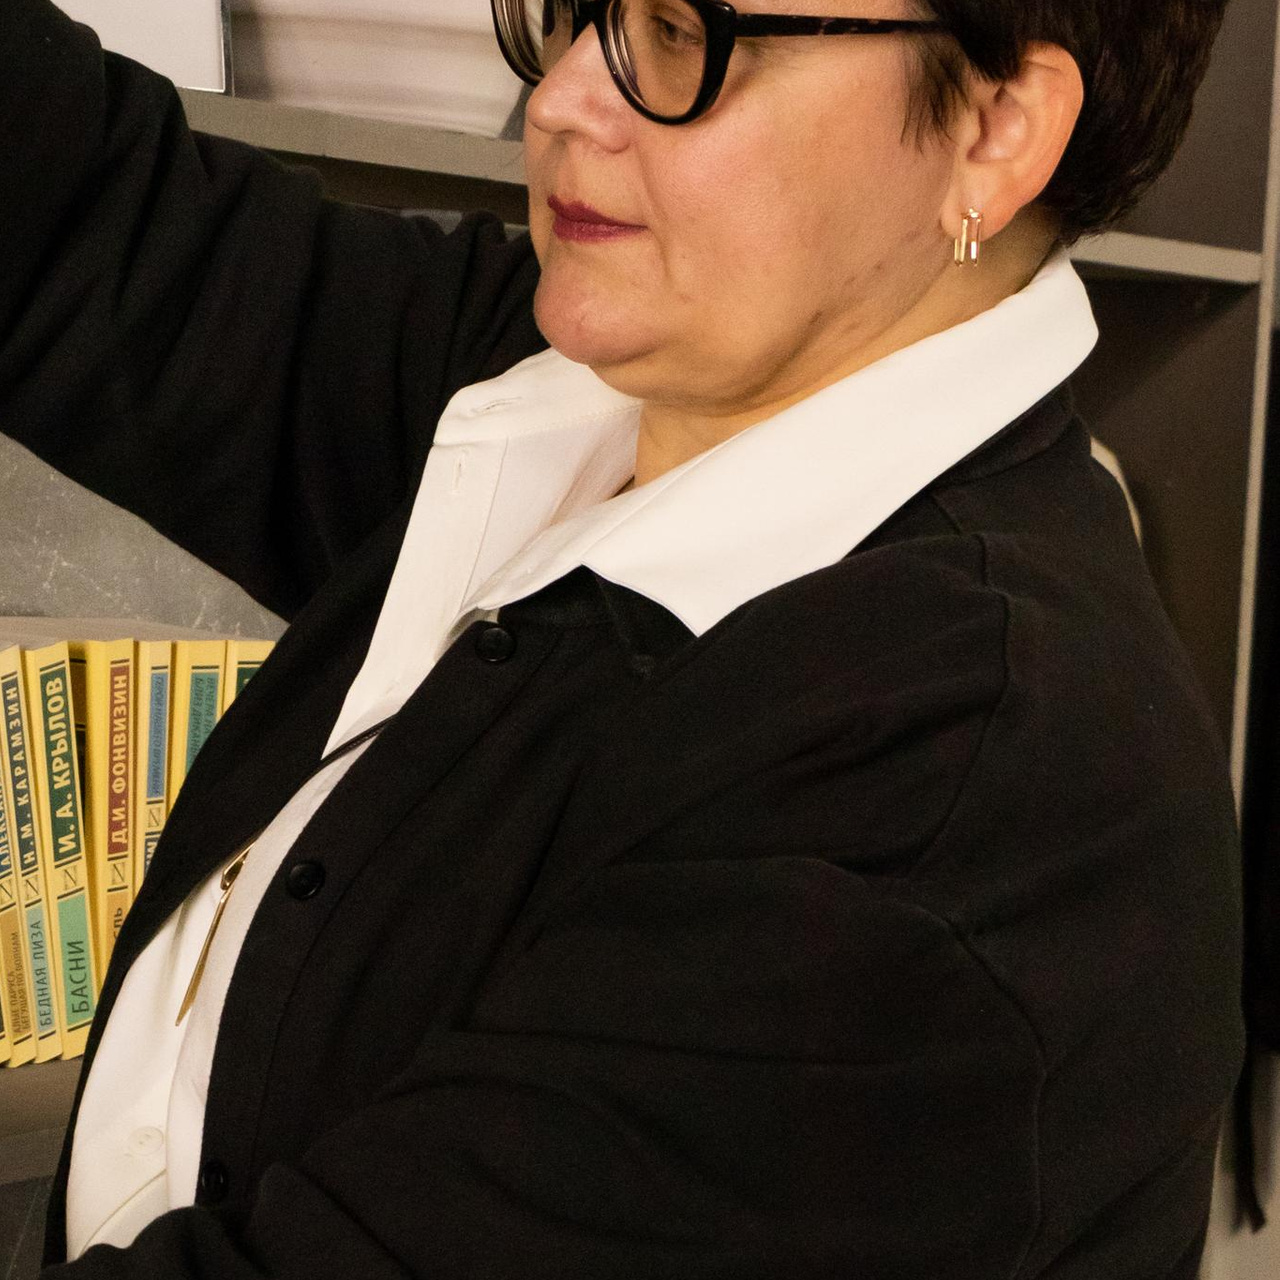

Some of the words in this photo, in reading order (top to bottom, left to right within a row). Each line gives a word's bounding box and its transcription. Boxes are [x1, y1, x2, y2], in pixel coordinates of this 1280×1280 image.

[5, 687, 29, 806] КАРАМЗИН
[45, 676, 71, 790] КРЫЛОВ
[111, 674, 128, 794] ФОНВИЗИН
[30, 919, 45, 962] ЛИЗА
[66, 940, 90, 1014] БАСНИ
[35, 965, 52, 1027] БЕДНАЯ
